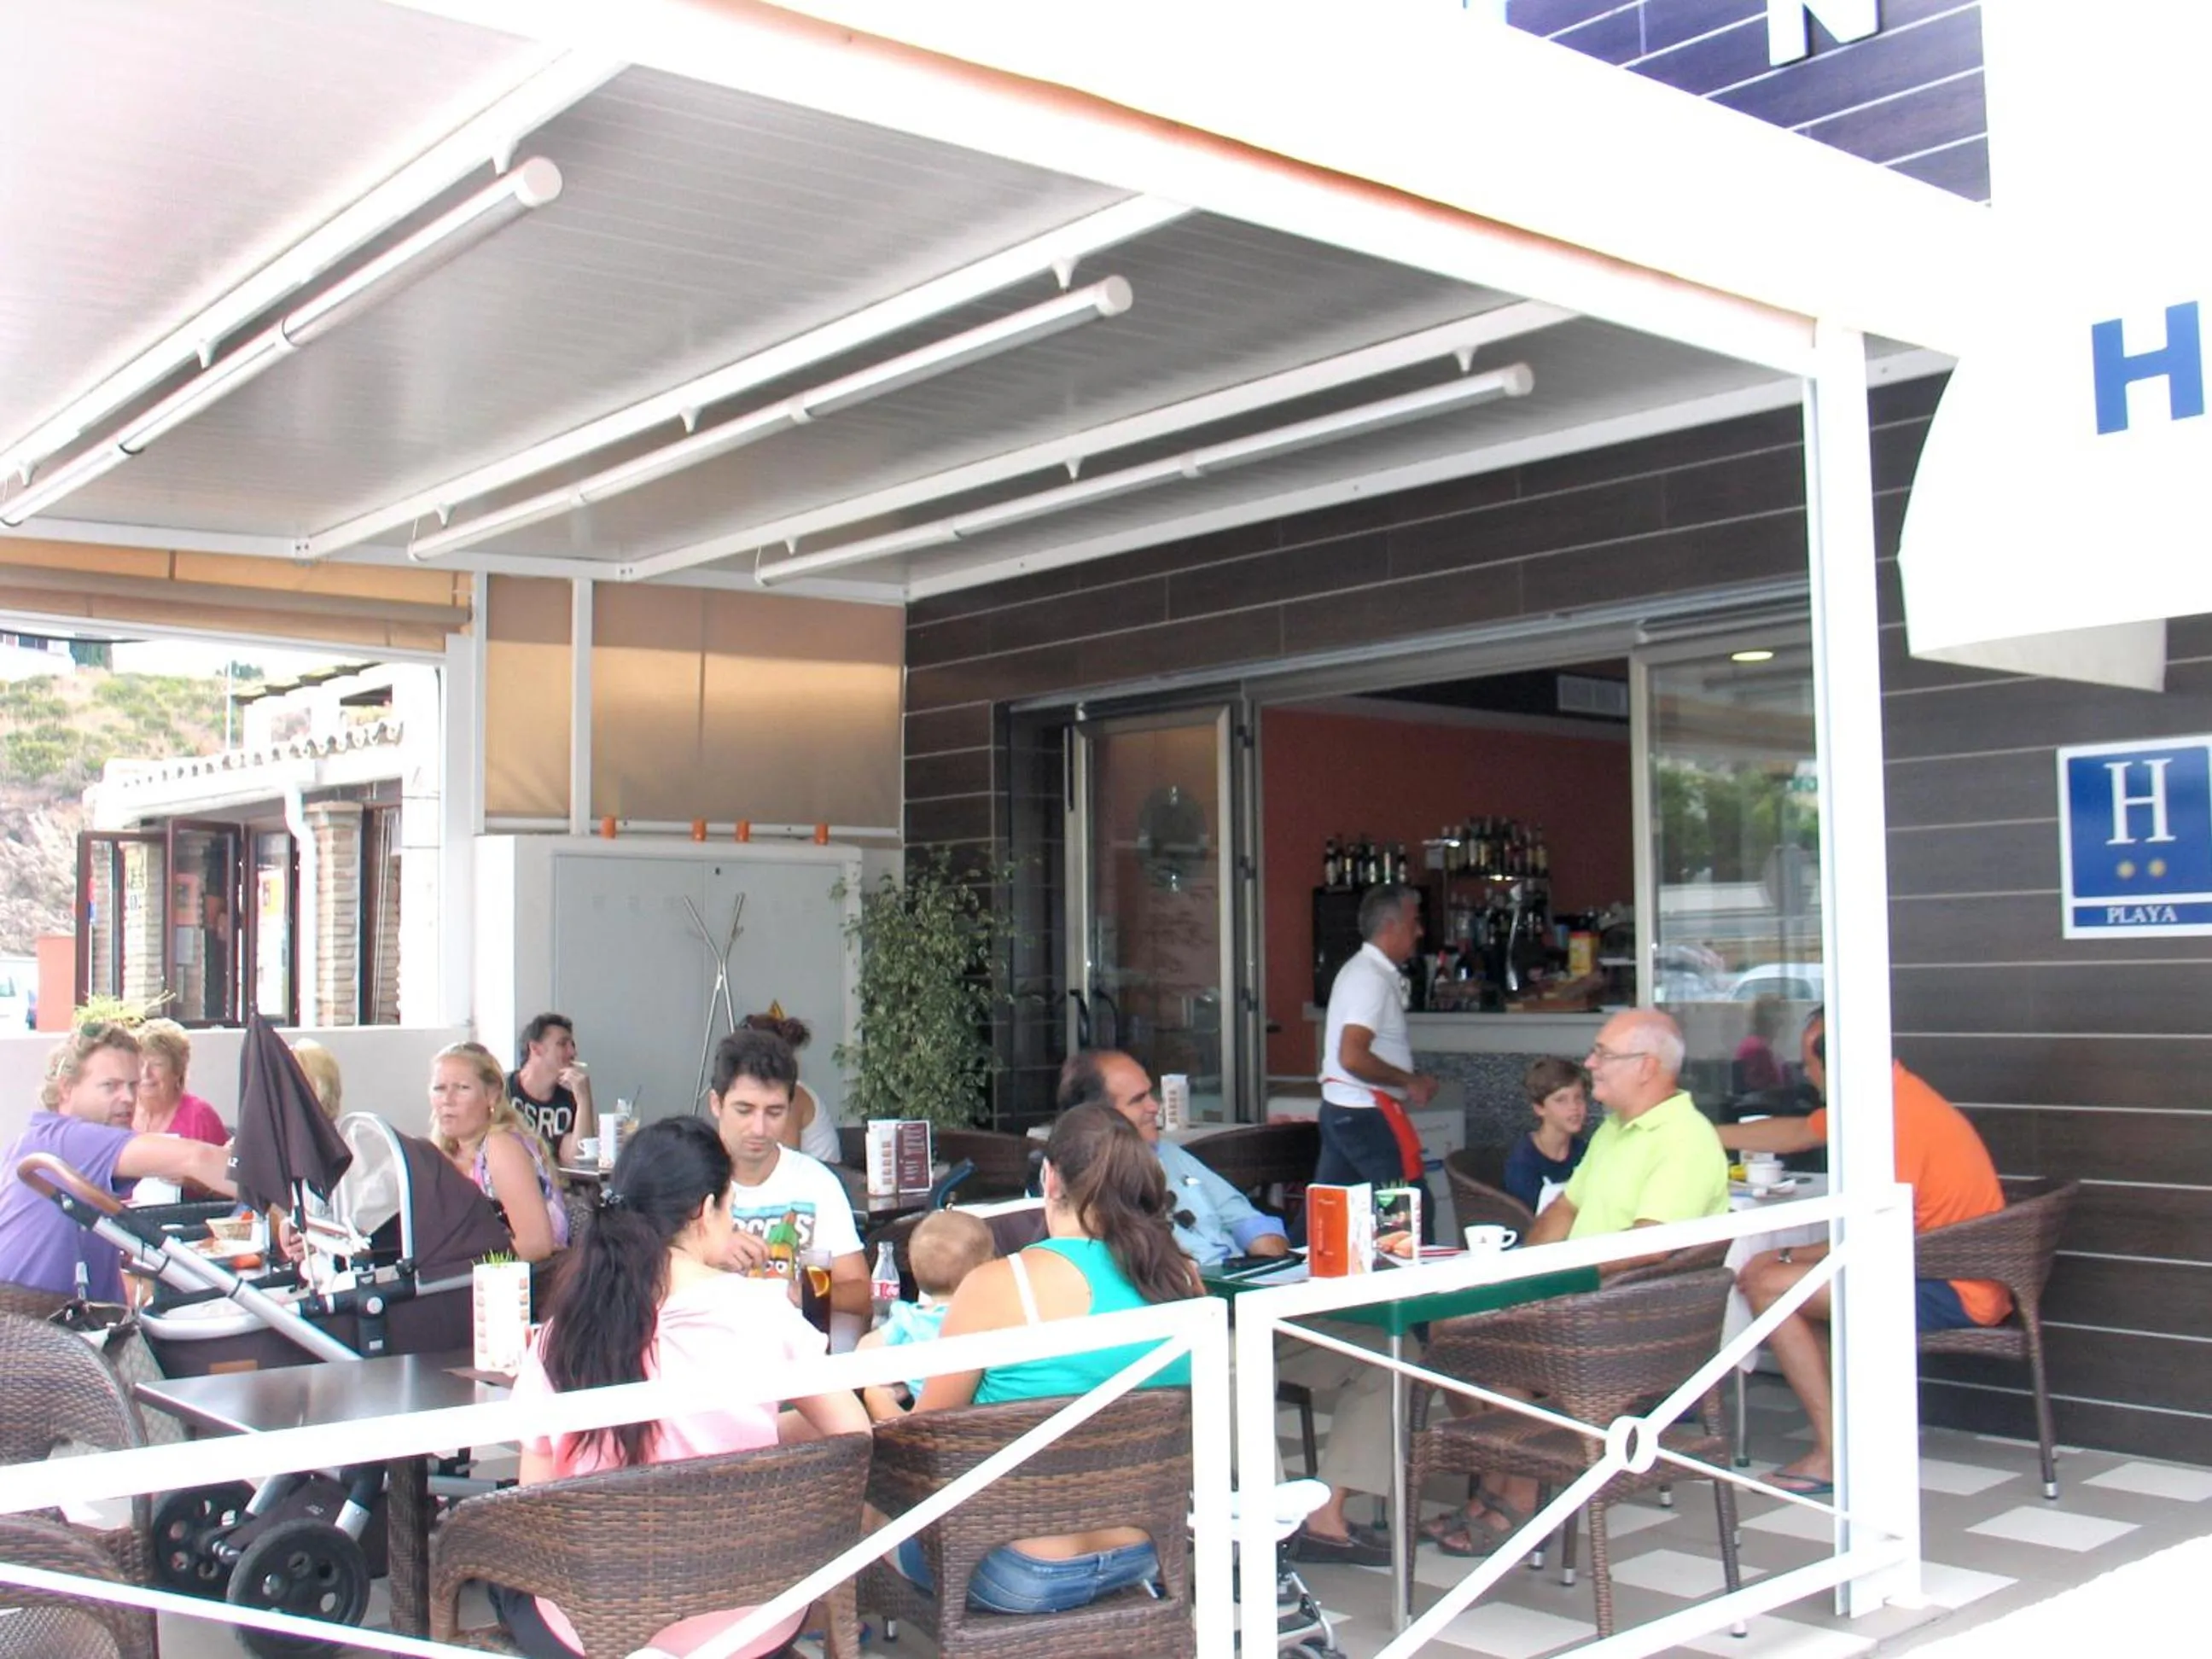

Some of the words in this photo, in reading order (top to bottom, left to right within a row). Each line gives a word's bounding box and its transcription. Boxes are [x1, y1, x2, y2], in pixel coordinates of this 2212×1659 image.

[2092, 300, 2204, 435] H
[2103, 758, 2177, 845] H
[2106, 905, 2178, 924] PLAYA
